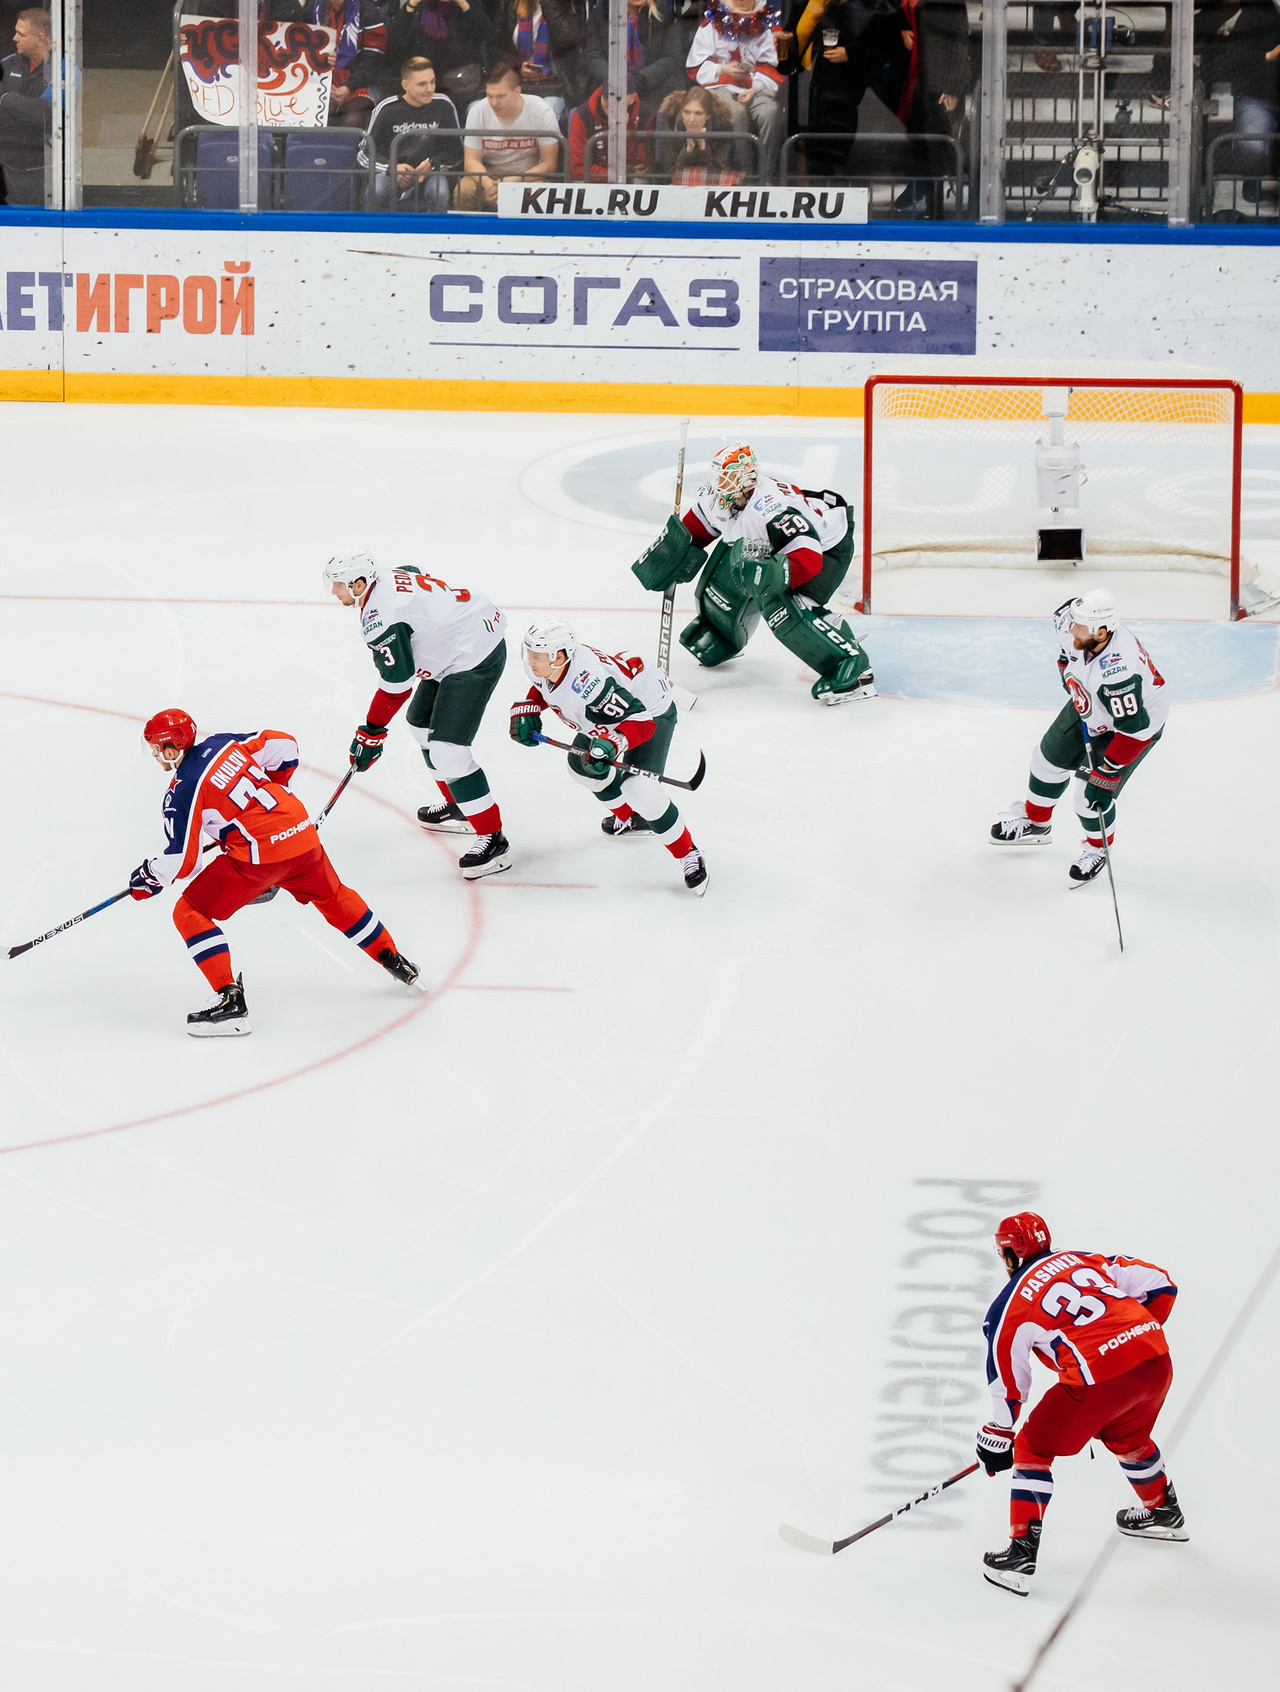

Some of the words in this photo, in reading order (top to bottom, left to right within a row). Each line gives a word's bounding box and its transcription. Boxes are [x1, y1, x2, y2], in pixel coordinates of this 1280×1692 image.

[189, 78, 235, 117] RED
[520, 188, 660, 216] KHL.RU
[704, 191, 846, 219] KHL.RU
[429, 274, 741, 328] СОГАЗ
[778, 277, 960, 302] СТРАХОВАЯ
[806, 309, 927, 332] ГРУППА
[812, 617, 860, 656] CCM
[380, 647, 396, 667] 3
[1101, 665, 1128, 679] KAZAN
[581, 677, 601, 700] KAZAN
[603, 693, 630, 718] 97
[1110, 693, 1138, 718] 89
[209, 748, 248, 790] OKULOV
[629, 766, 659, 781] CCM
[33, 914, 83, 947] NEXUS
[1035, 1230, 1046, 1243] 33
[1041, 1267, 1128, 1326] 33
[1098, 1321, 1161, 1356] РОСНЕФТЬ
[892, 1483, 943, 1520] CCM
